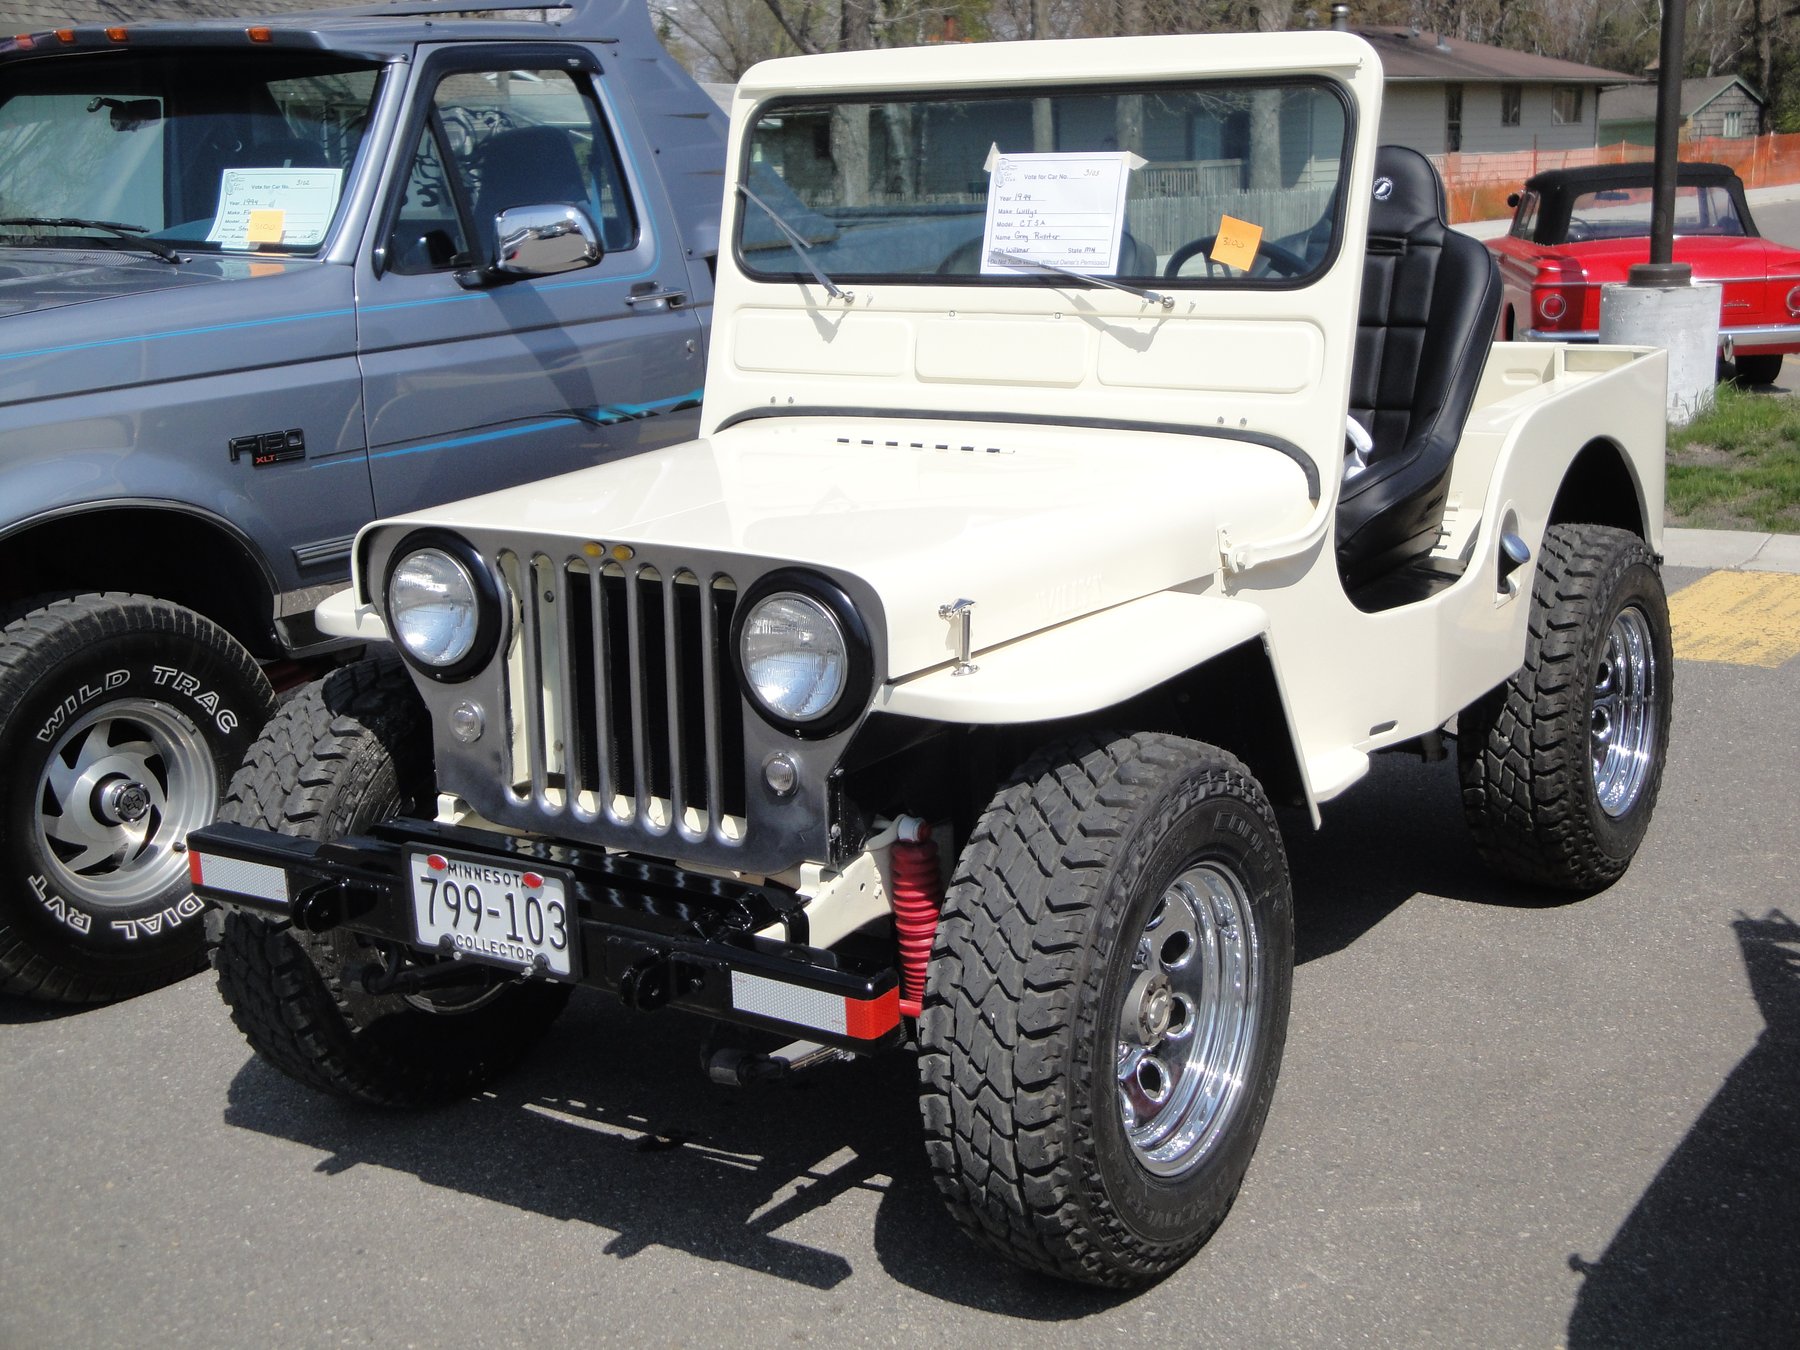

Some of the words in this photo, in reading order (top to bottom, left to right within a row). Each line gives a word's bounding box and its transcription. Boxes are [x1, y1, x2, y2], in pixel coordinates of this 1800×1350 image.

[256, 454, 275, 464] XLT
[36, 668, 132, 743] WILD
[152, 664, 238, 734] TRAC
[28, 874, 92, 935] RVT
[111, 892, 206, 940] DIAL
[420, 875, 567, 951] 799-103
[455, 933, 535, 961] COLLECTOR
